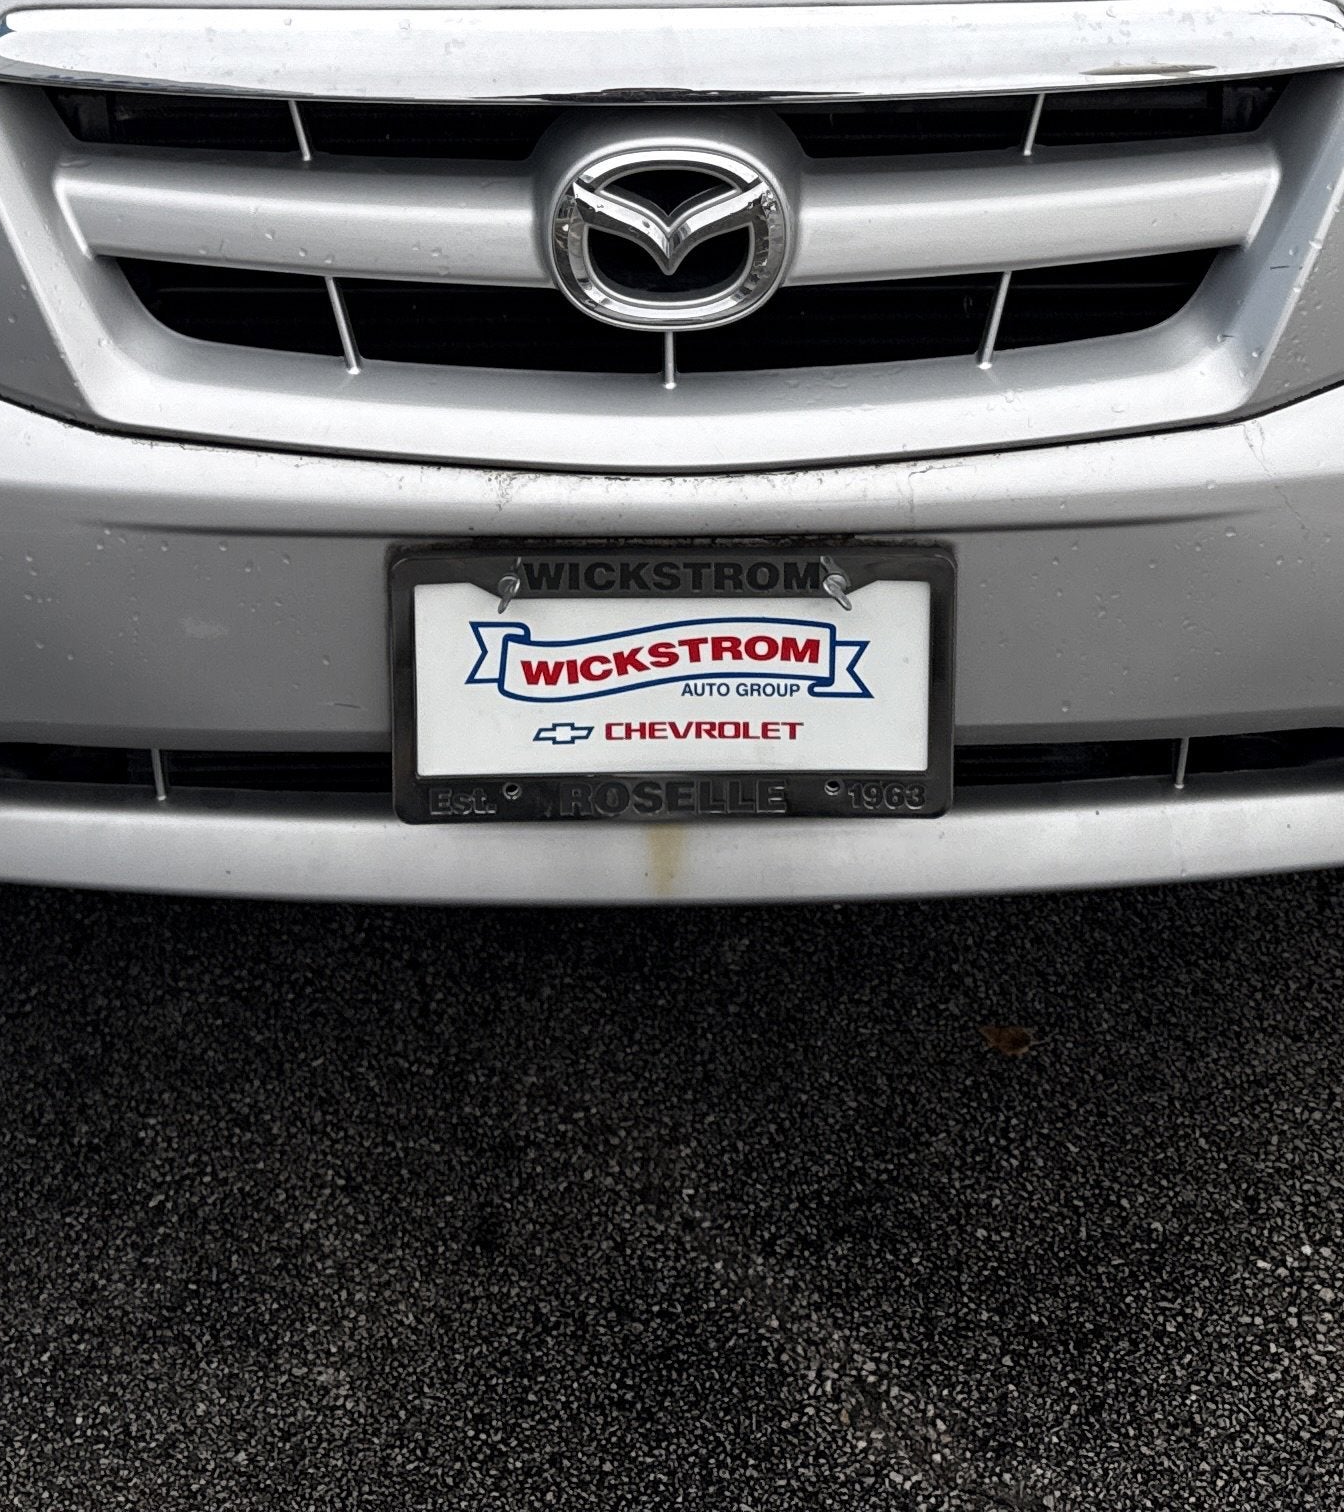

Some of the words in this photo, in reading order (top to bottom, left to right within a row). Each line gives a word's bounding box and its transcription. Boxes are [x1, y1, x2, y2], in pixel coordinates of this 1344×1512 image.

[523, 561, 821, 592] WICKSTROM
[520, 635, 821, 686] WICKSTROM
[681, 682, 730, 697] AUTO
[736, 682, 801, 697] GROUP
[605, 721, 804, 740] CHEVROLET
[429, 788, 496, 816] Est.
[559, 779, 788, 816] ROSELLE
[848, 783, 927, 810] 1963
